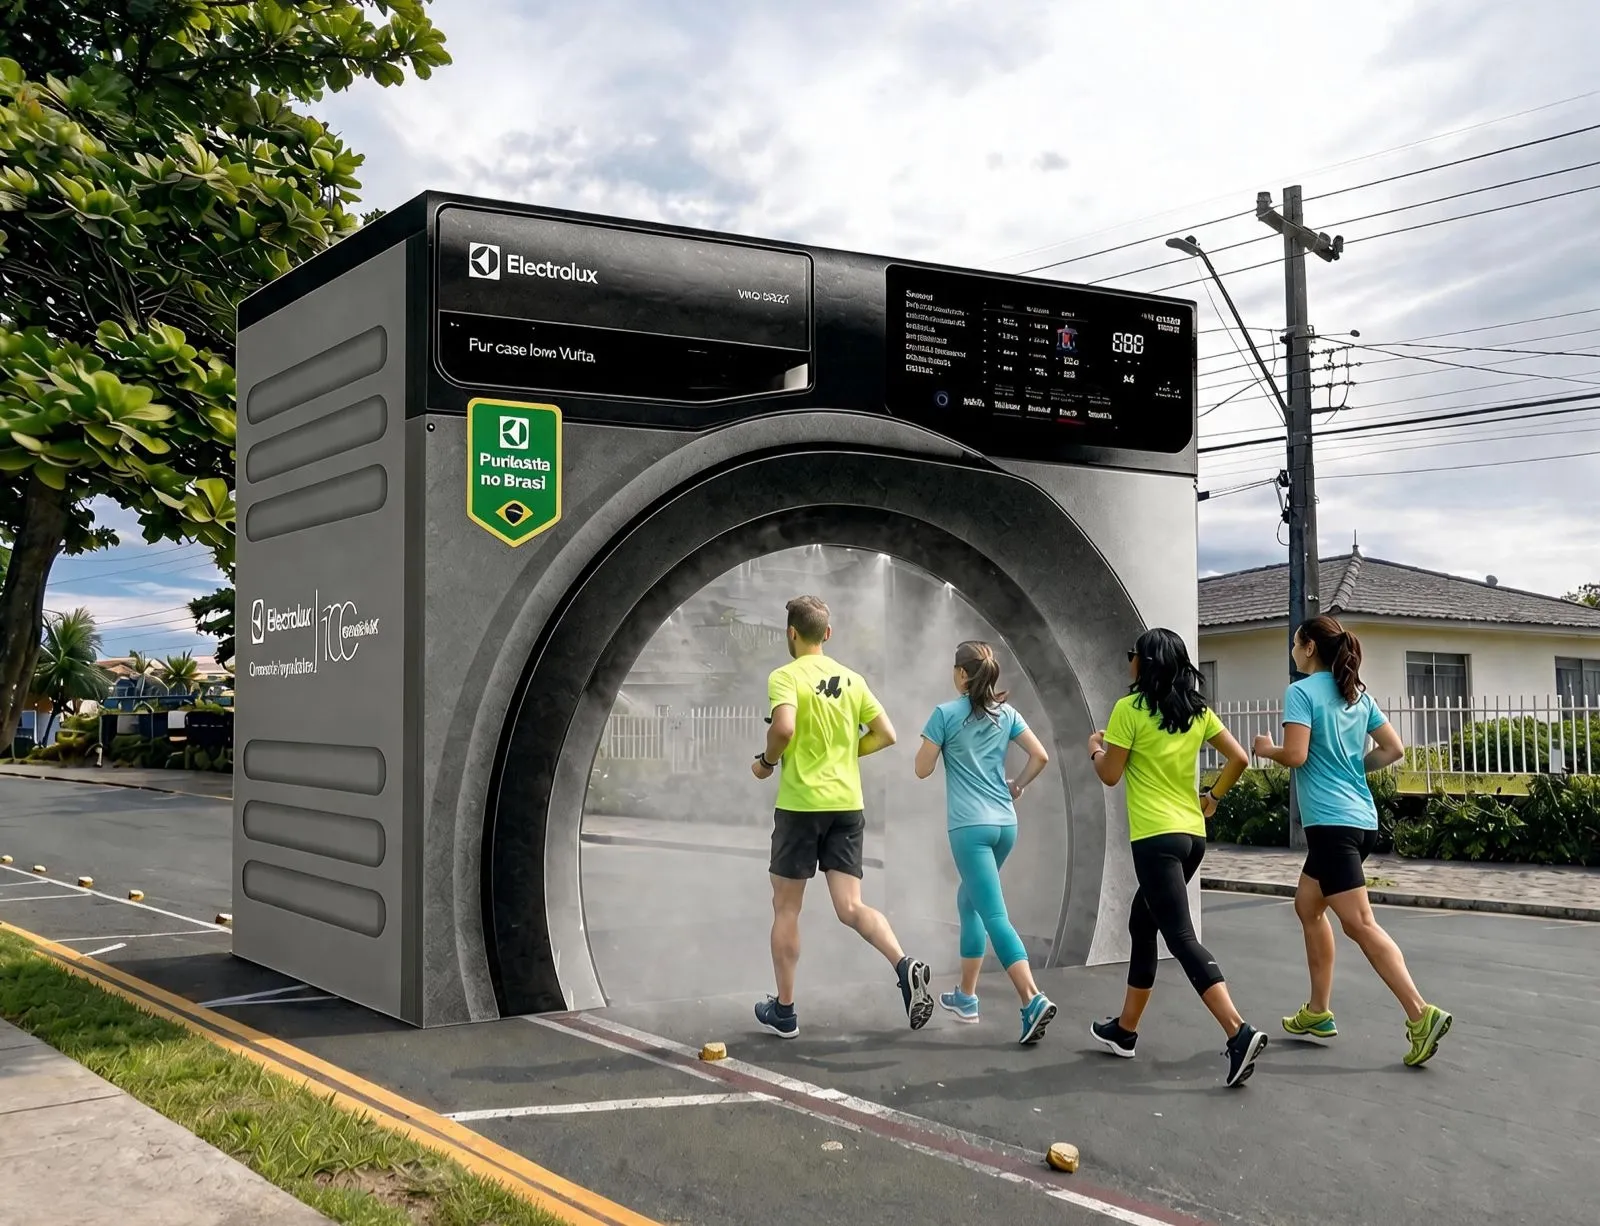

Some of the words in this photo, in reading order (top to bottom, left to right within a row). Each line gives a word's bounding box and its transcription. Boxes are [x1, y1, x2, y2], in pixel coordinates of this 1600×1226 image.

[507, 254, 598, 284] Electrolux
[495, 343, 527, 356] case
[480, 474, 501, 486] no
